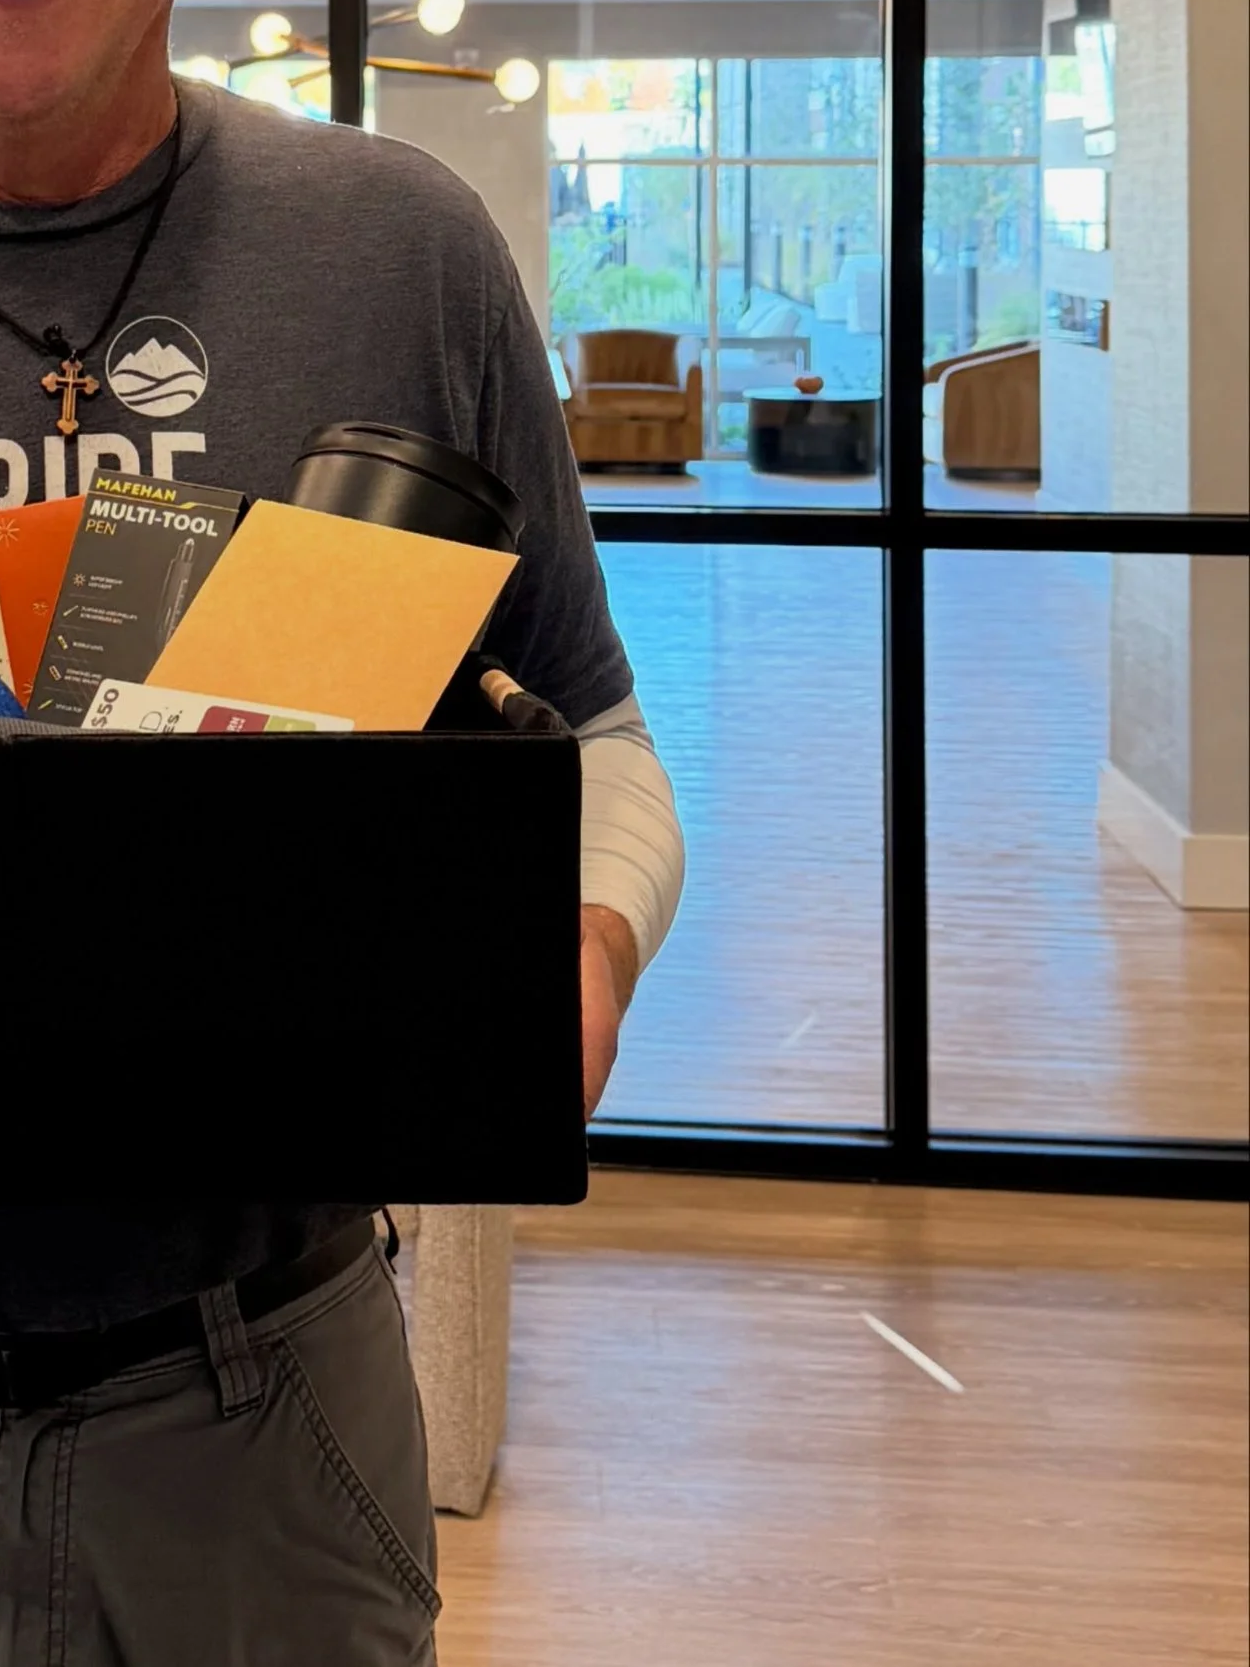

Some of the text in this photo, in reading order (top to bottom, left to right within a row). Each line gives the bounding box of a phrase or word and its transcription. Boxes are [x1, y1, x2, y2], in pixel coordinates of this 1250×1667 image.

[96, 477, 177, 502] MAFEHAN
[84, 519, 117, 536] PEN
[90, 499, 219, 538] MULTI-TOOL
[91, 688, 120, 728] $50
